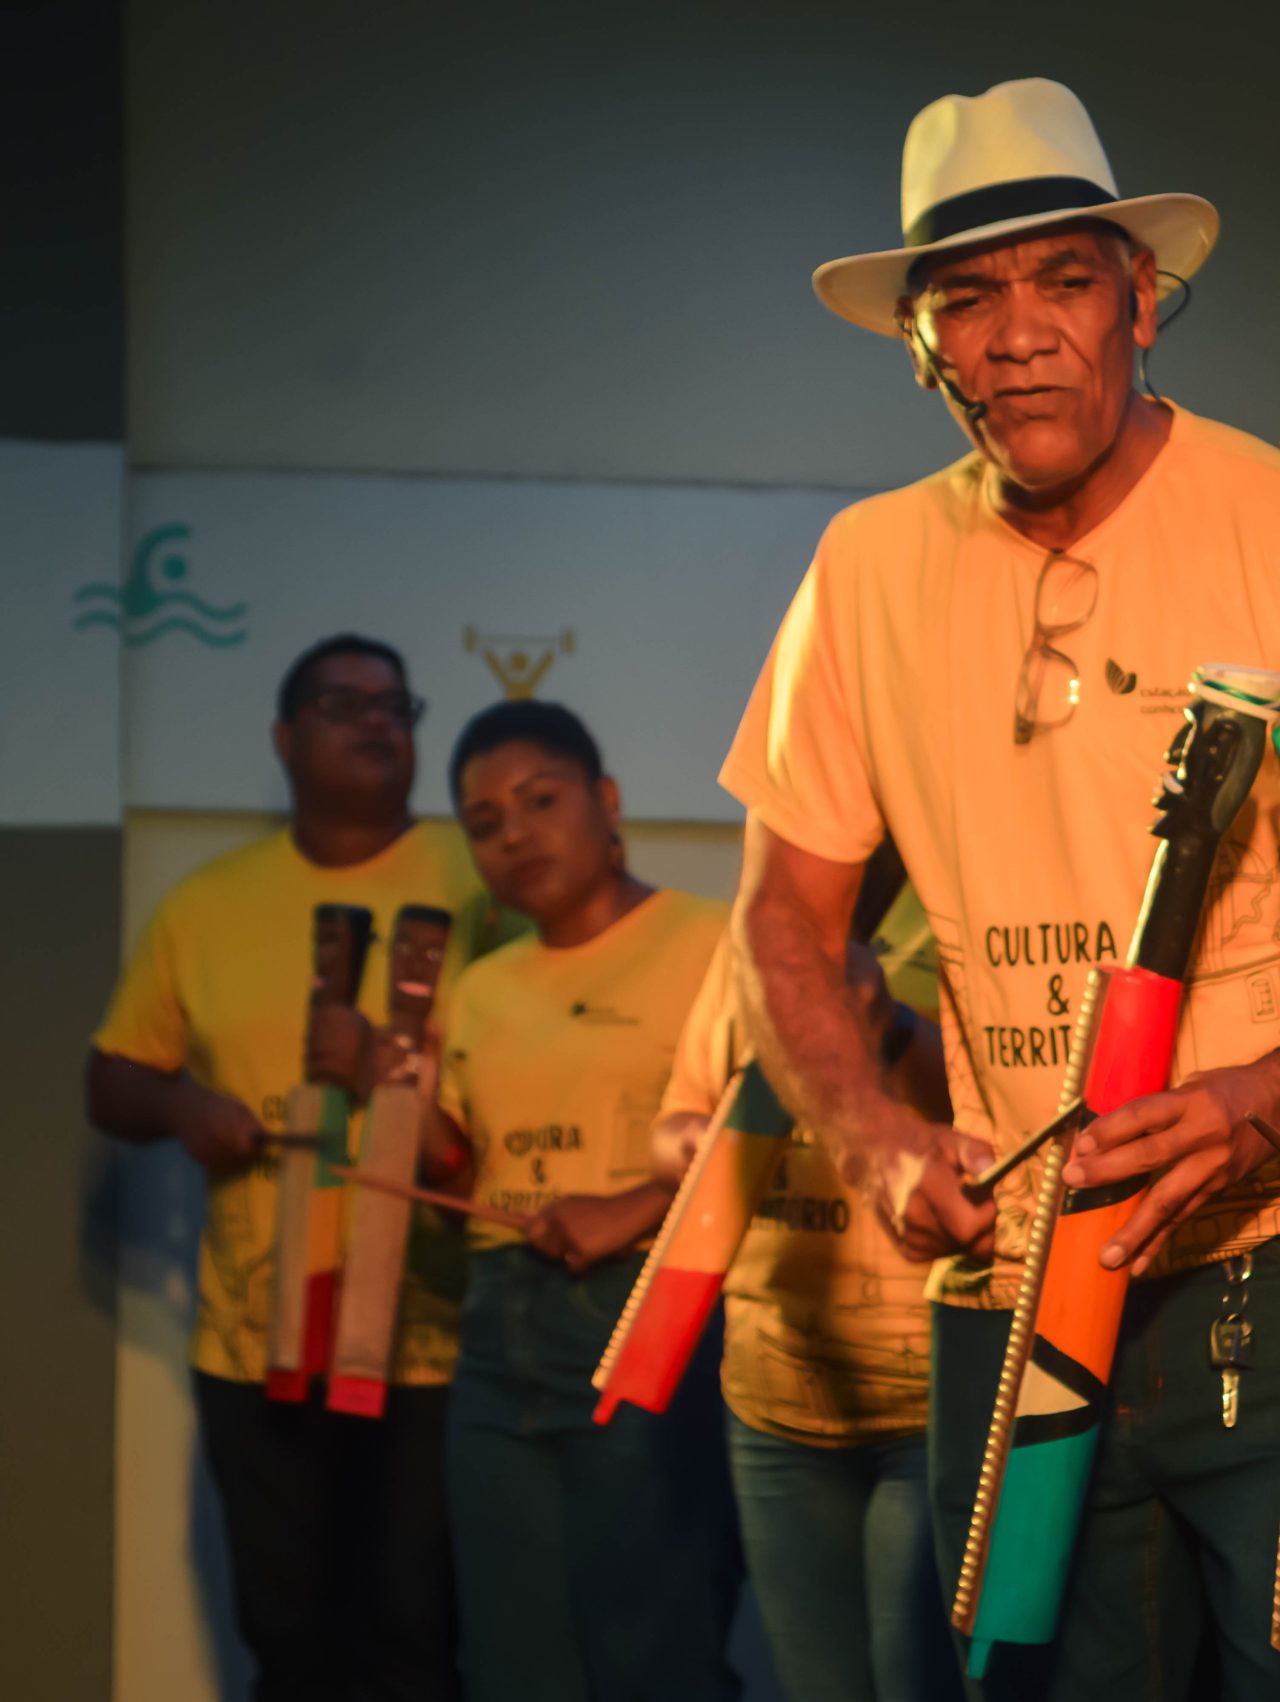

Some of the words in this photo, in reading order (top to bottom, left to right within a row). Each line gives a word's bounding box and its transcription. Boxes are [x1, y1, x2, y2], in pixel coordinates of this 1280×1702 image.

[986, 921, 1117, 967] CULTURA
[1047, 973, 1070, 1016] &
[984, 1024, 1071, 1067] TERRIT
